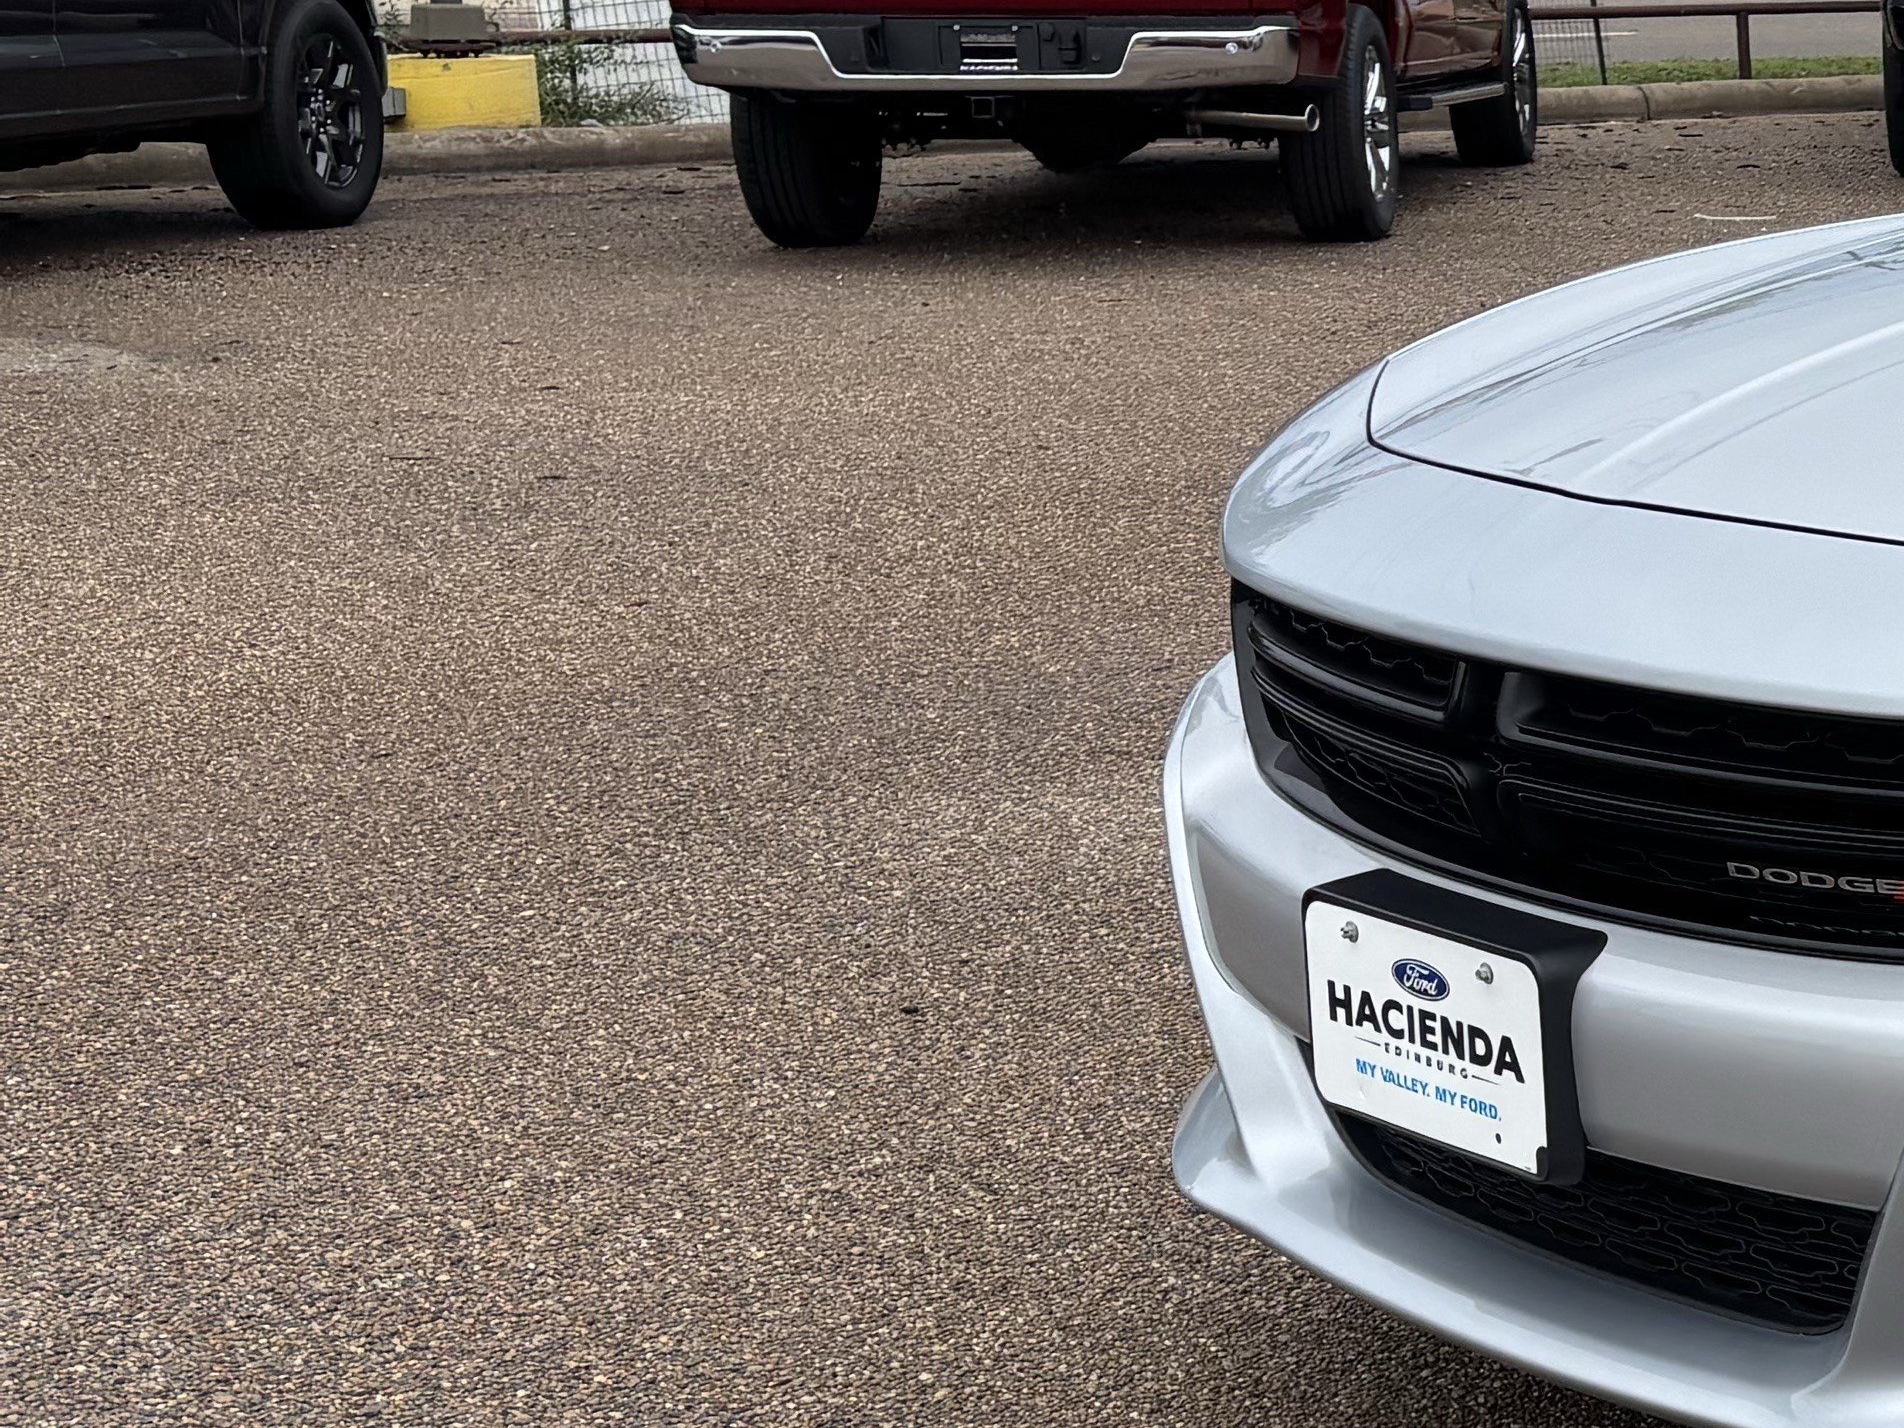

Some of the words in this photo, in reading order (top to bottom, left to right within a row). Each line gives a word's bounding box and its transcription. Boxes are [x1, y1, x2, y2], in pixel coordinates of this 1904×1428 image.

[1402, 963, 1439, 996] Ford
[1326, 979, 1526, 1085] HACIENDA
[1384, 1042, 1469, 1080] EDINBURG
[1355, 1058, 1377, 1079] MY
[1380, 1066, 1430, 1097] VALLEY.
[1434, 1087, 1457, 1108] MY
[1460, 1094, 1502, 1122] FORD.
